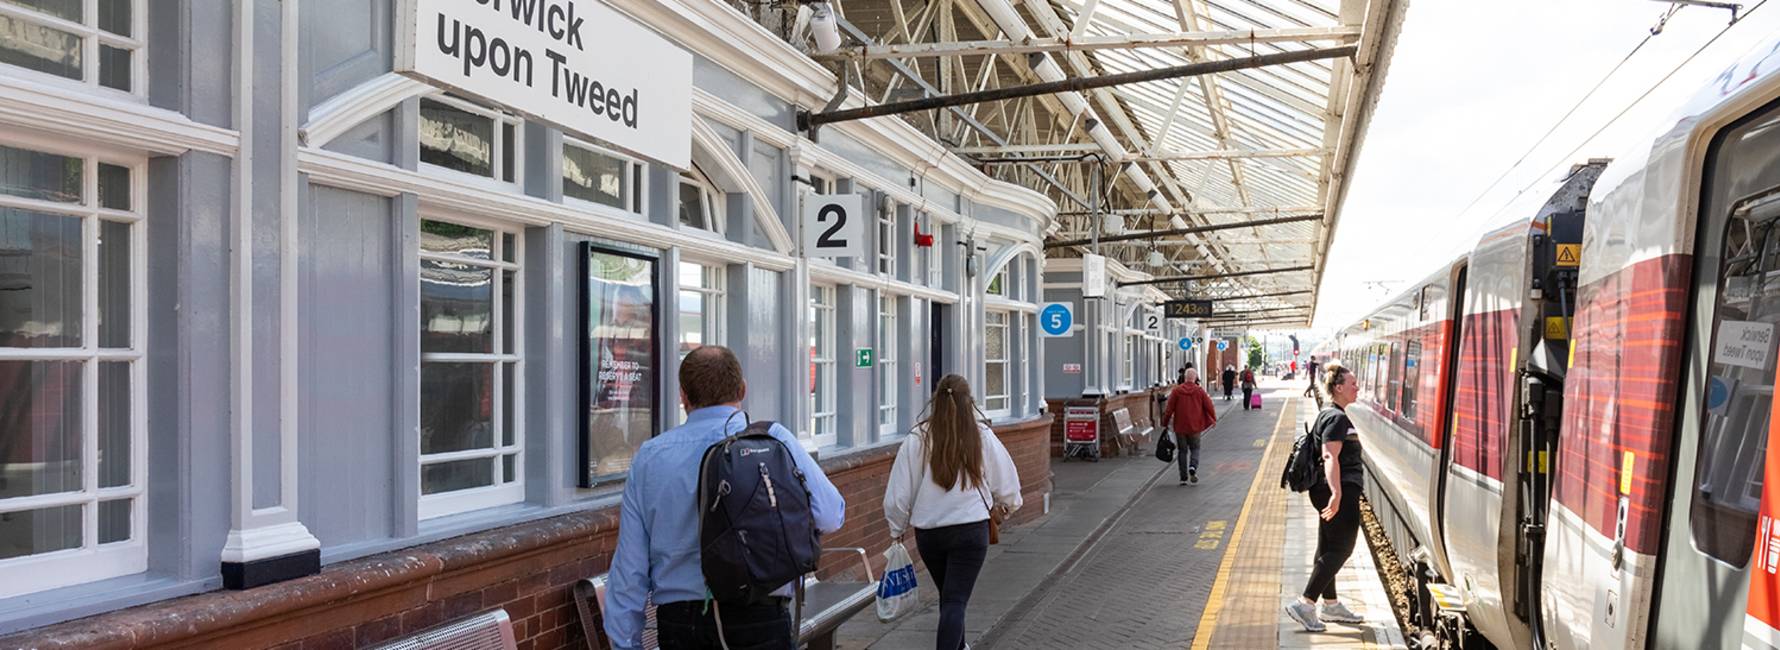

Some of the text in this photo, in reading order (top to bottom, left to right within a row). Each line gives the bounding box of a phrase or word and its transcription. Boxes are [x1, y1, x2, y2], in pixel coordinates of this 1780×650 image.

[437, 13, 639, 130] upon Tweed
[816, 203, 848, 248] 2
[1051, 313, 1062, 329] 5
[1148, 315, 1158, 329] 2
